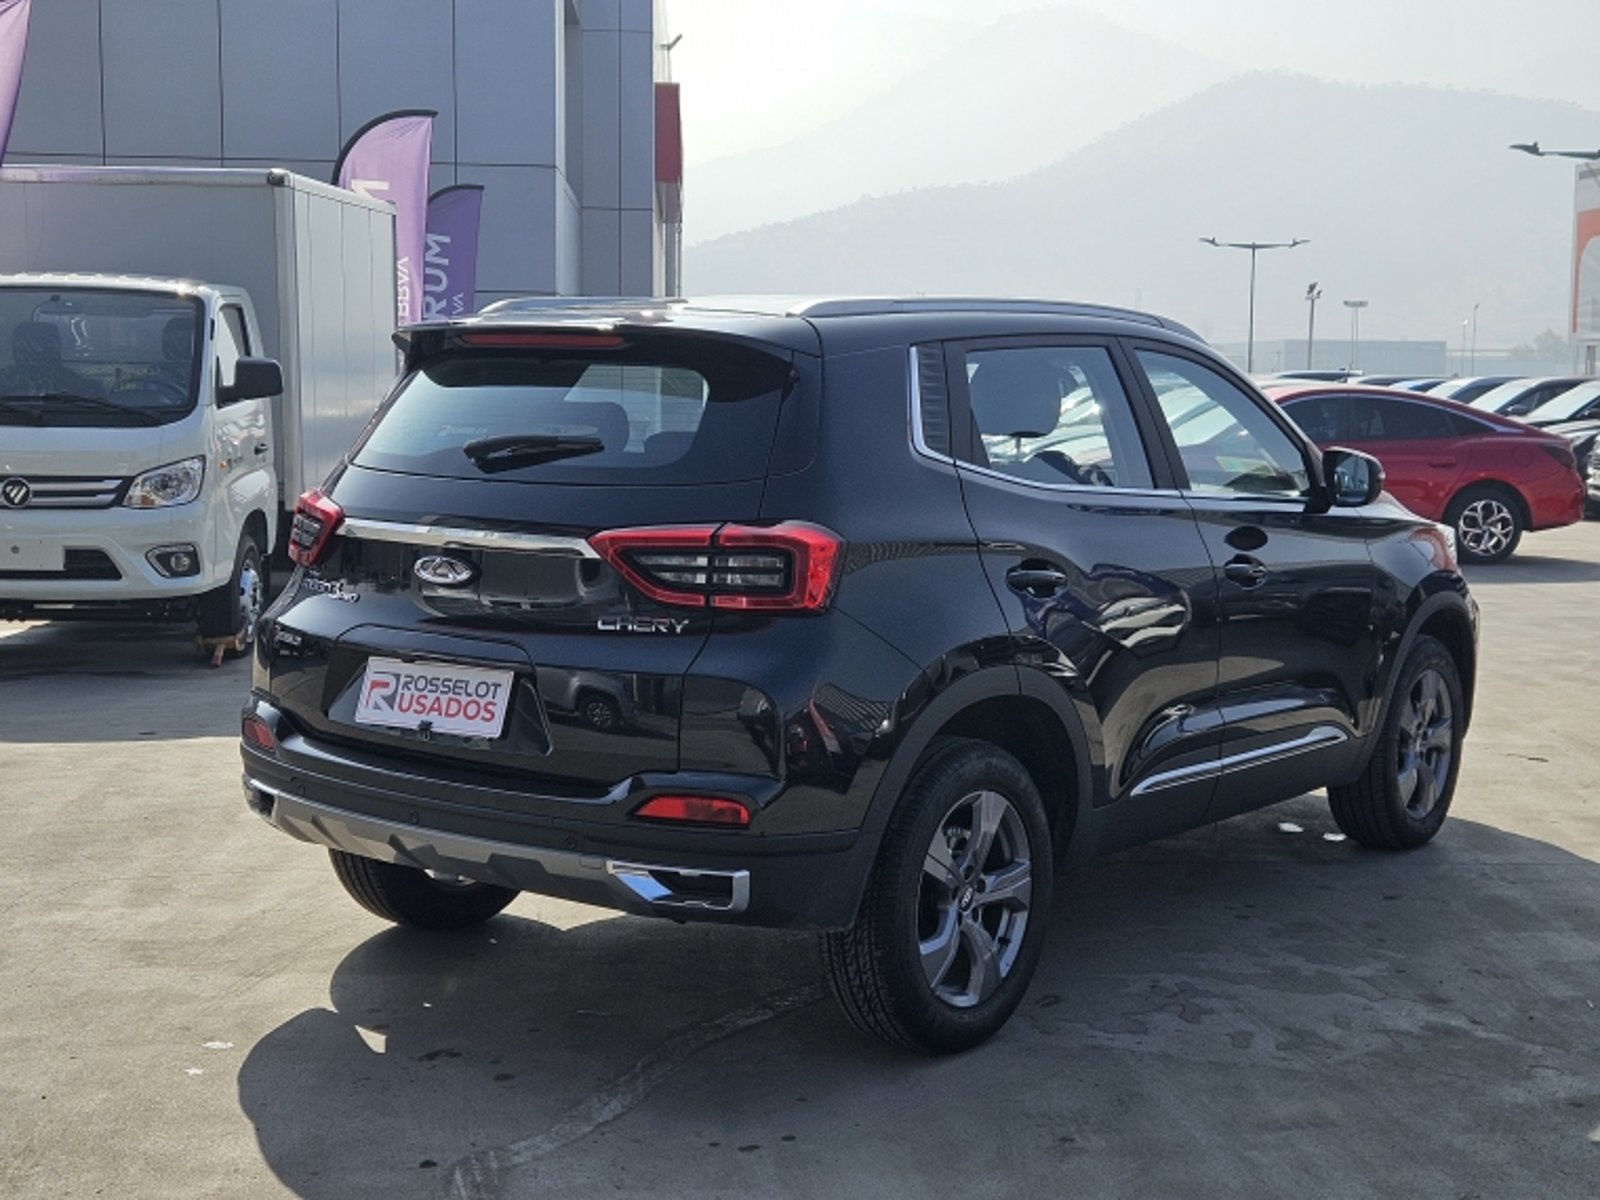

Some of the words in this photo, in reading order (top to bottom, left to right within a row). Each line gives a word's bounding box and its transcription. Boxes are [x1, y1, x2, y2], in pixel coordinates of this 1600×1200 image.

[597, 616, 688, 634] CHERY
[402, 674, 502, 699] ROSSELOT
[398, 693, 497, 722] USADOS
